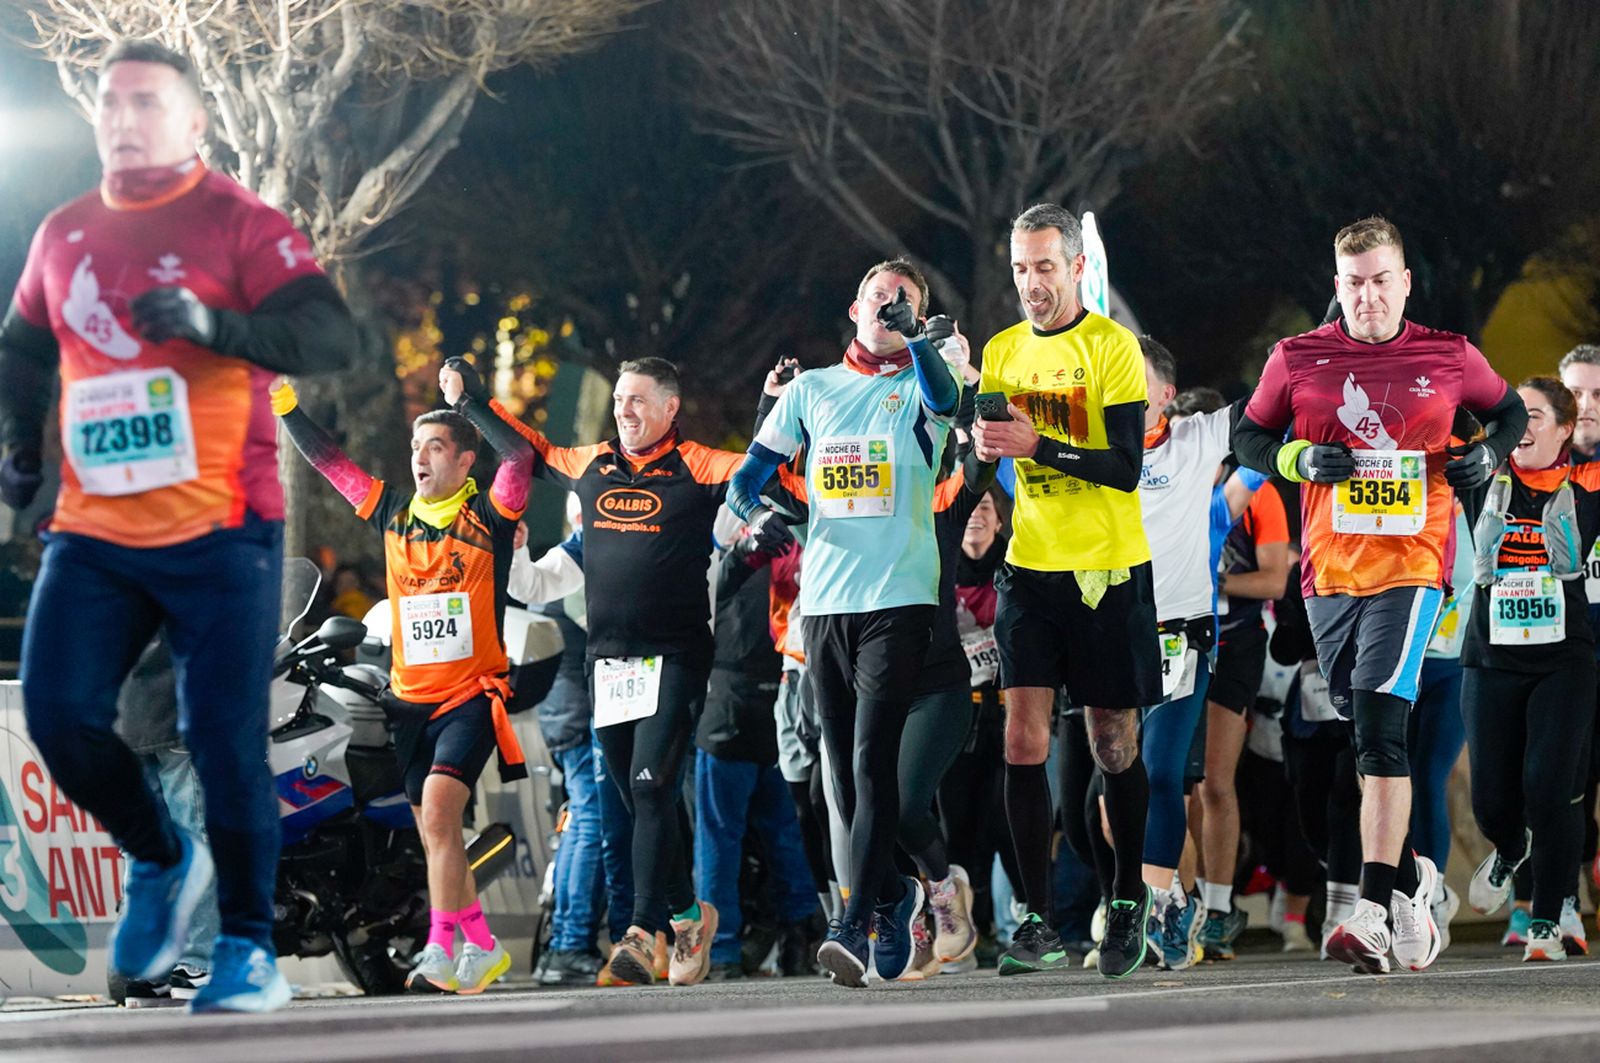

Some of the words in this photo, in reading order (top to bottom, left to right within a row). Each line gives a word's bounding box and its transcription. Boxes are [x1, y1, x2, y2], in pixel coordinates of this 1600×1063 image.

[84, 313, 113, 344] 43
[81, 412, 174, 456] 12398
[1355, 417, 1380, 439] 43
[825, 445, 848, 454] NOCHE
[850, 444, 861, 454] DE
[818, 456, 832, 465] SAN
[833, 452, 862, 464] ANTÓN
[1382, 460, 1393, 469] DE
[823, 464, 880, 491] 5355
[1146, 475, 1169, 486] APO
[1362, 468, 1393, 480] ANTÓN
[1349, 480, 1411, 507] 5354
[604, 498, 652, 511] GALBIS
[1525, 580, 1534, 588] DE
[1510, 587, 1535, 597] ANTÓN
[1498, 598, 1557, 620] 13956
[413, 618, 458, 641] 5924
